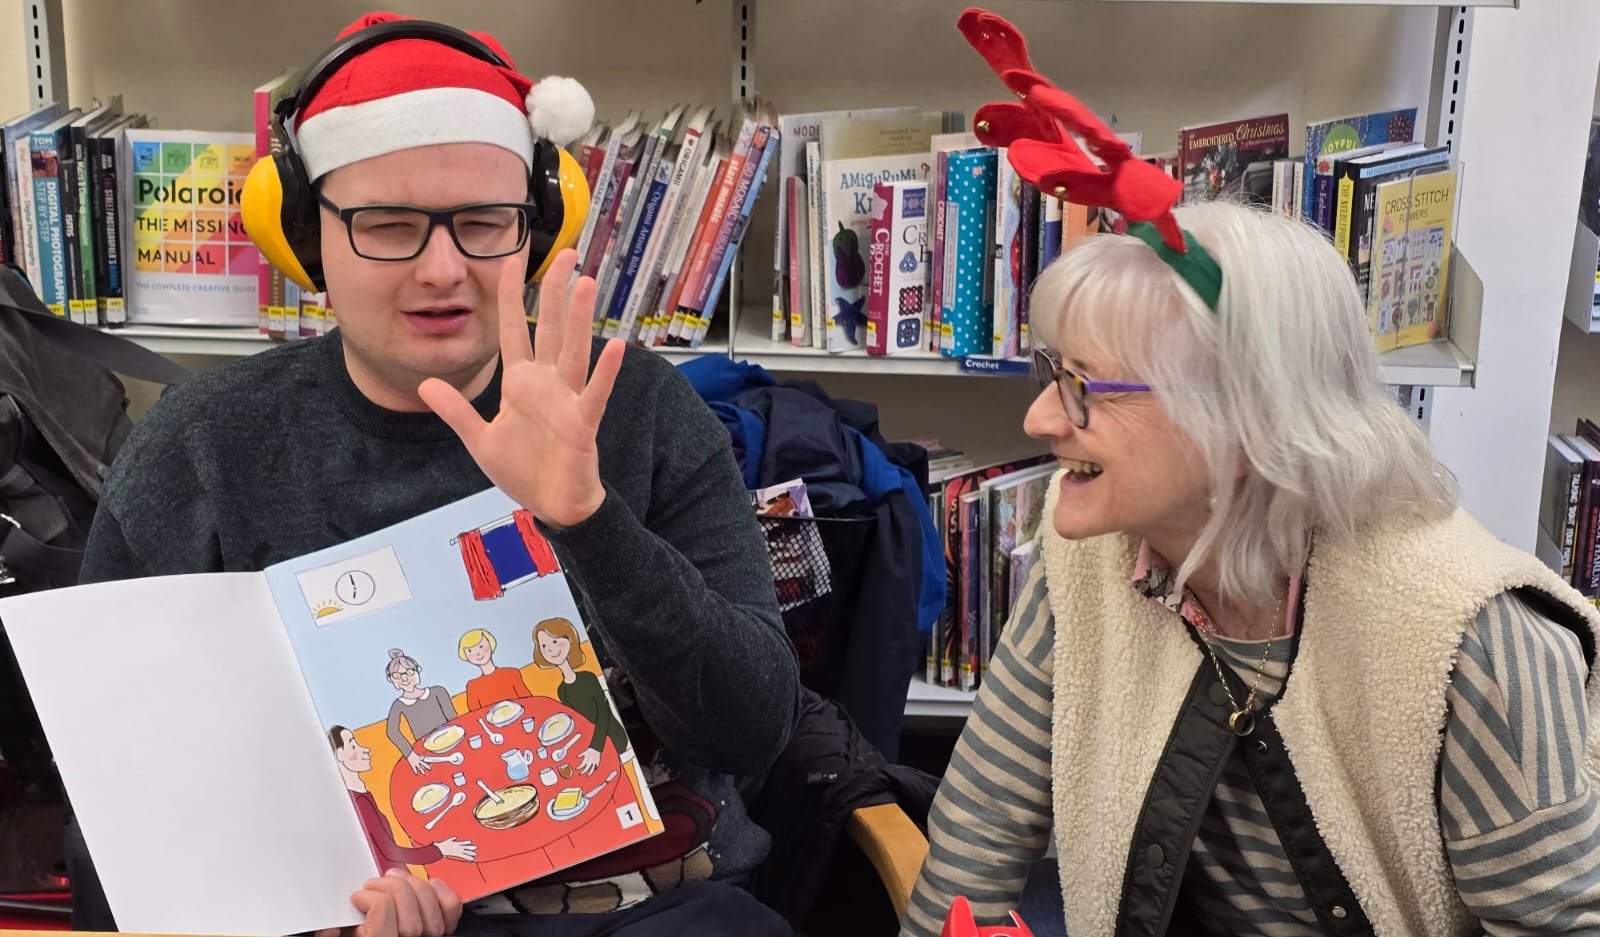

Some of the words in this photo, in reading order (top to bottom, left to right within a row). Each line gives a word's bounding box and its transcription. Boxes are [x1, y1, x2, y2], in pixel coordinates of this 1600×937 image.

[1189, 133, 1235, 150] EMBROIDERED
[1236, 122, 1285, 141] Christmas
[725, 159, 738, 184] start
[36, 181, 48, 203] STEP
[105, 189, 114, 211] STREET
[593, 172, 609, 205] vintage
[728, 179, 749, 218] MOSAIC
[1385, 195, 1413, 215] CROSS
[1415, 188, 1449, 208] STITCH
[23, 200, 33, 222] Digital
[38, 205, 48, 219] BY
[46, 182, 58, 223] DIGITAL
[642, 190, 660, 225] Origami
[711, 186, 729, 223] mosaic
[1364, 193, 1375, 212] NE
[40, 220, 49, 242] STEP
[65, 214, 75, 237] isms
[136, 217, 168, 232] THE
[937, 201, 945, 241] CROCHET
[1338, 200, 1349, 249] NEEDLEPOINT
[24, 224, 36, 266] Photography
[633, 226, 648, 254] Artist's
[711, 221, 732, 261] MURALS
[50, 227, 66, 306] PHOTOGRAPHY
[138, 248, 216, 265] MANUAL
[625, 256, 638, 276] Bible
[873, 227, 890, 296] CROCHET
[136, 282, 150, 290] THE
[152, 282, 190, 292] COMPLETE
[192, 284, 230, 293] CREATIVE
[233, 285, 256, 293] GUIDE
[965, 360, 999, 369] Crochet
[1570, 473, 1581, 503] TALKING
[1565, 527, 1575, 546] YOUR
[625, 810, 634, 821] 1
